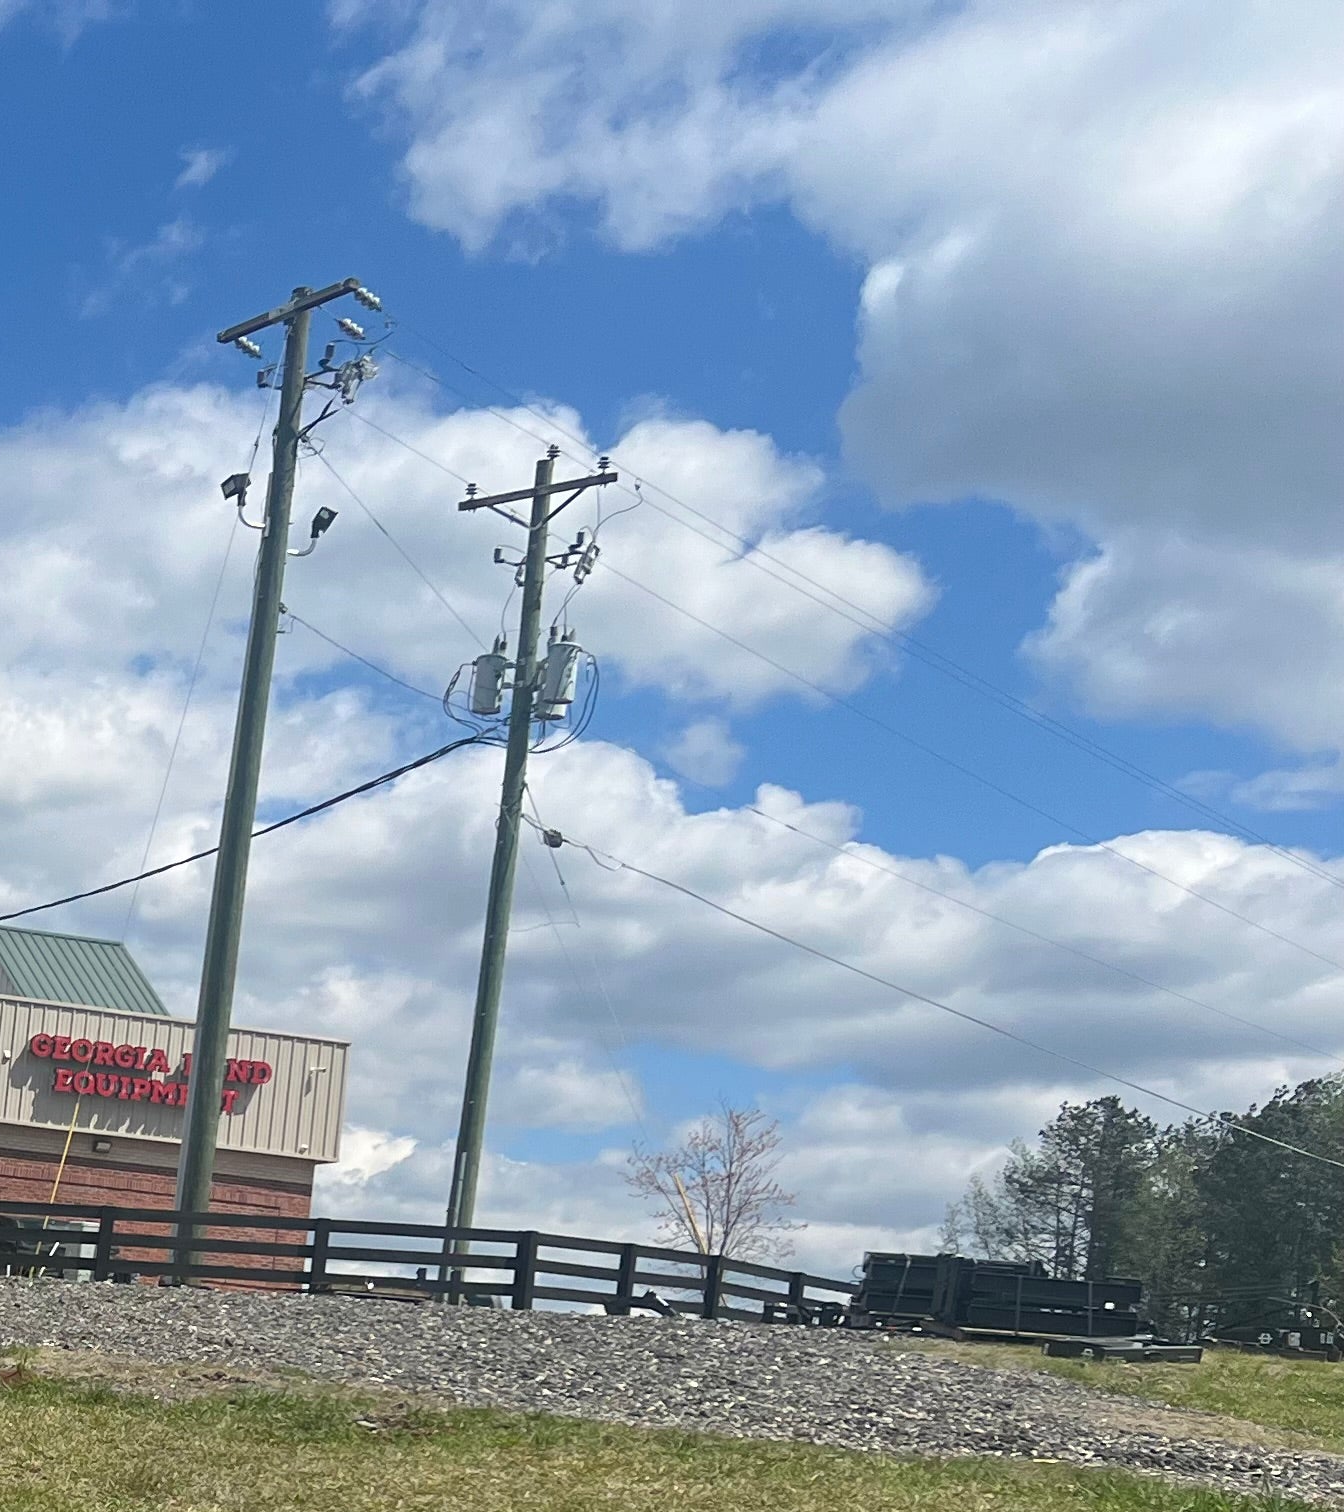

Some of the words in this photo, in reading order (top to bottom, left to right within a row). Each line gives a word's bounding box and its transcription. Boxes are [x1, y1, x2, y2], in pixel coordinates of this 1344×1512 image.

[30, 1033, 170, 1072] GEORGIA
[182, 1053, 273, 1085] ND
[53, 1068, 240, 1114] EQUIPMT
